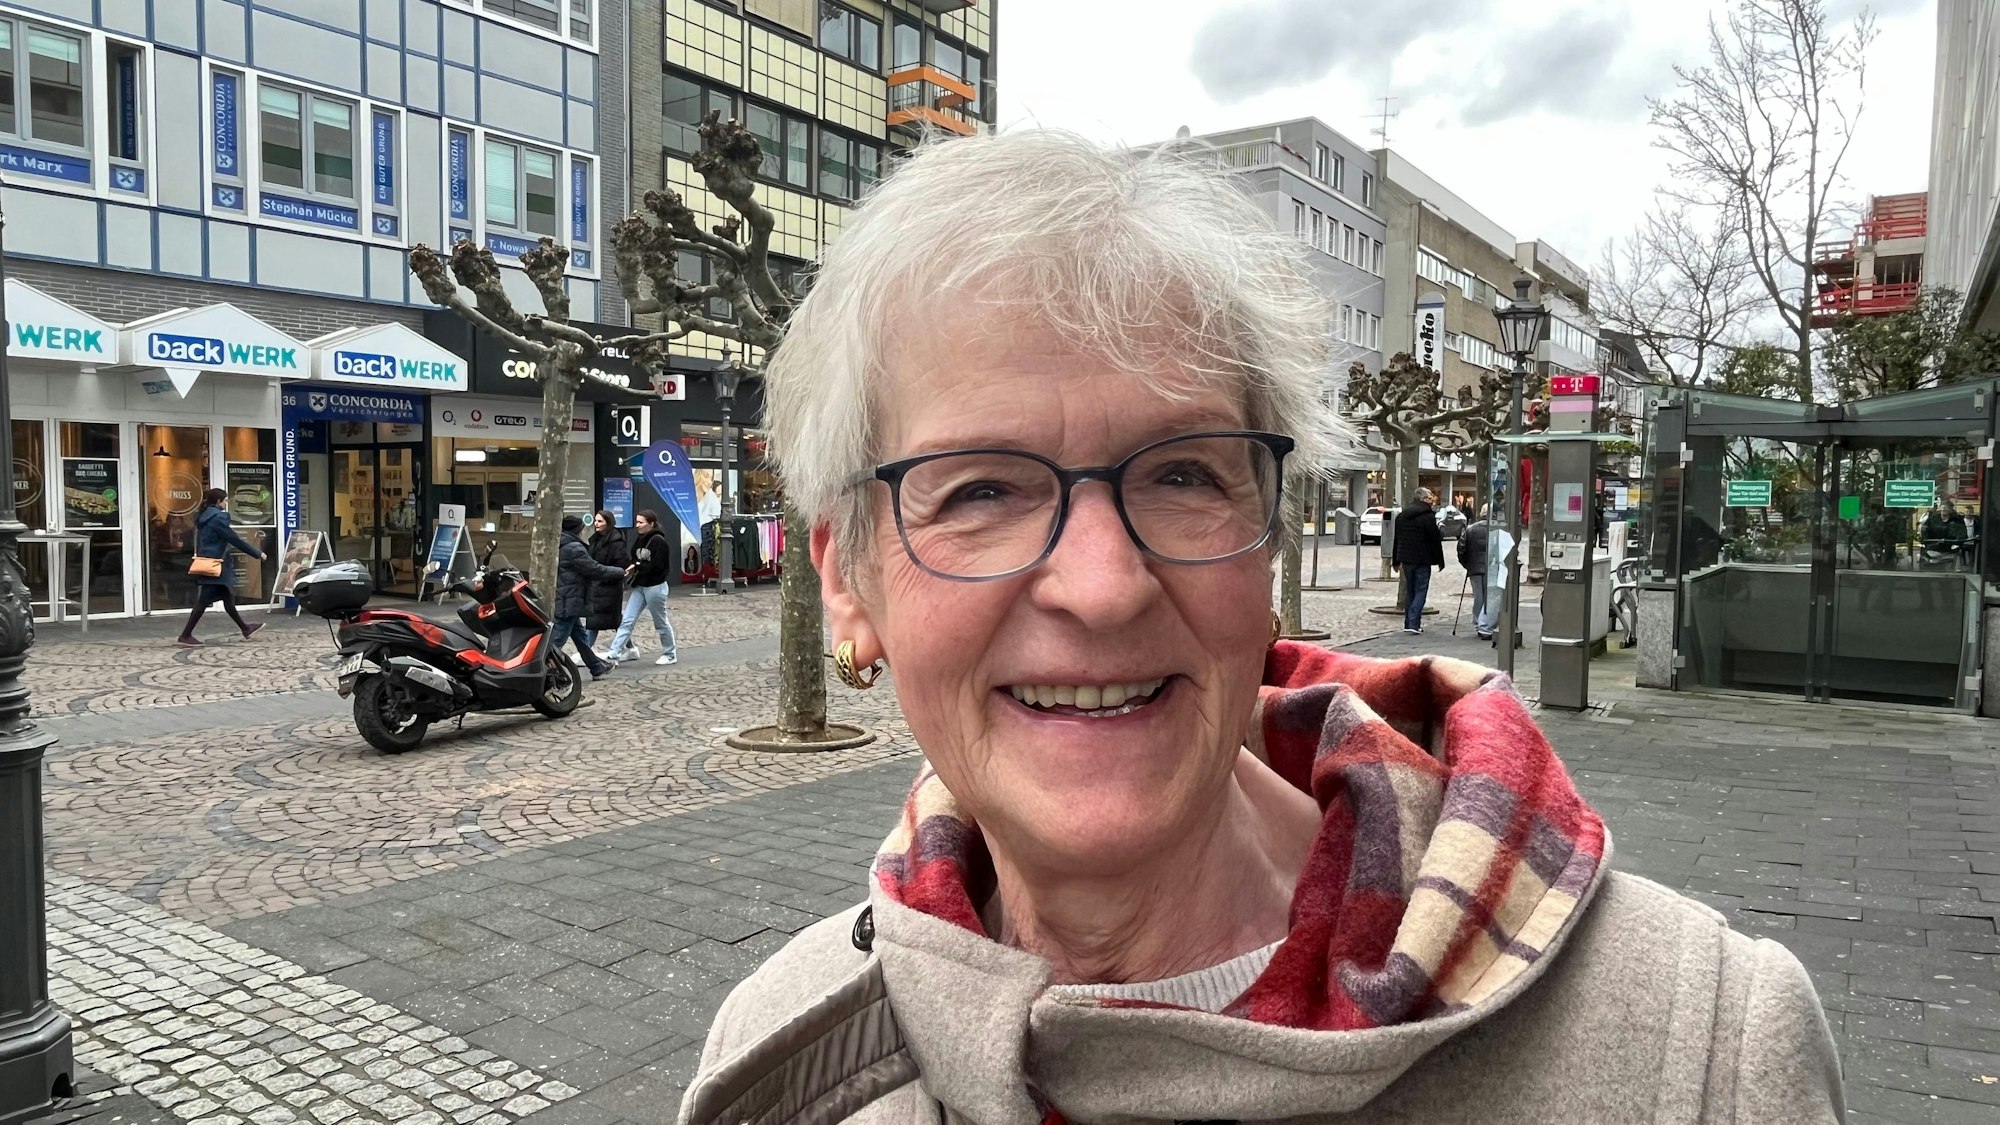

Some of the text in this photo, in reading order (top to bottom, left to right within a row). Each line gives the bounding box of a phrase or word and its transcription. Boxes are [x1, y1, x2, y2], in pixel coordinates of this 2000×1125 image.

[215, 83, 227, 152] CONCORDIA
[23, 155, 63, 174] Marx
[378, 154, 386, 183] GUTER
[451, 139, 460, 199] CONCORDIA
[379, 184, 387, 200] EIN
[262, 199, 354, 224] Stephan Mücke
[489, 239, 497, 249] T.
[16, 323, 103, 354] WERK
[152, 333, 297, 369] back WERK
[336, 352, 457, 383] back WERK
[1570, 377, 1583, 392] T
[282, 395, 297, 406] 36
[329, 394, 413, 411] CONCORDIA
[331, 406, 414, 419] Versicherungen
[285, 428, 297, 528] EIN GUTER GRUND.
